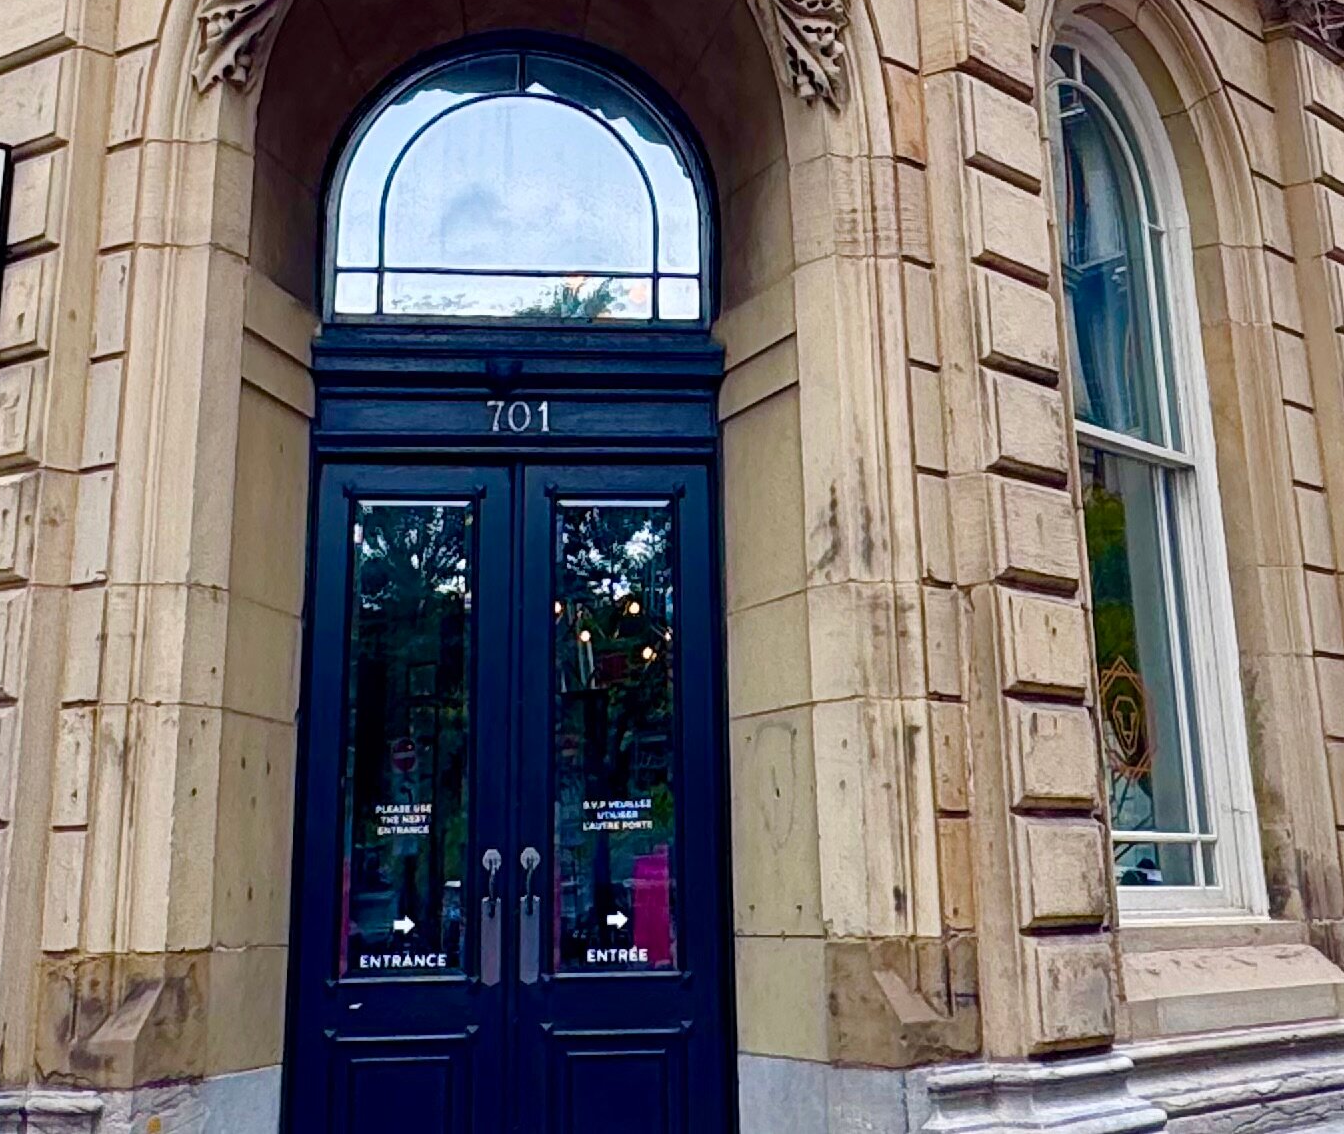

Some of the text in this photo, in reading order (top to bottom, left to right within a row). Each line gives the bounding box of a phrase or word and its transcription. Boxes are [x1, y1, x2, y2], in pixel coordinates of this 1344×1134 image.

[486, 400, 550, 432] 701
[375, 804, 411, 814] PLEASE
[377, 825, 430, 835] ENTRANCE
[622, 820, 653, 830] PORTE
[359, 952, 447, 968] ENTRANCE
[586, 945, 649, 963] ENTRÉE
